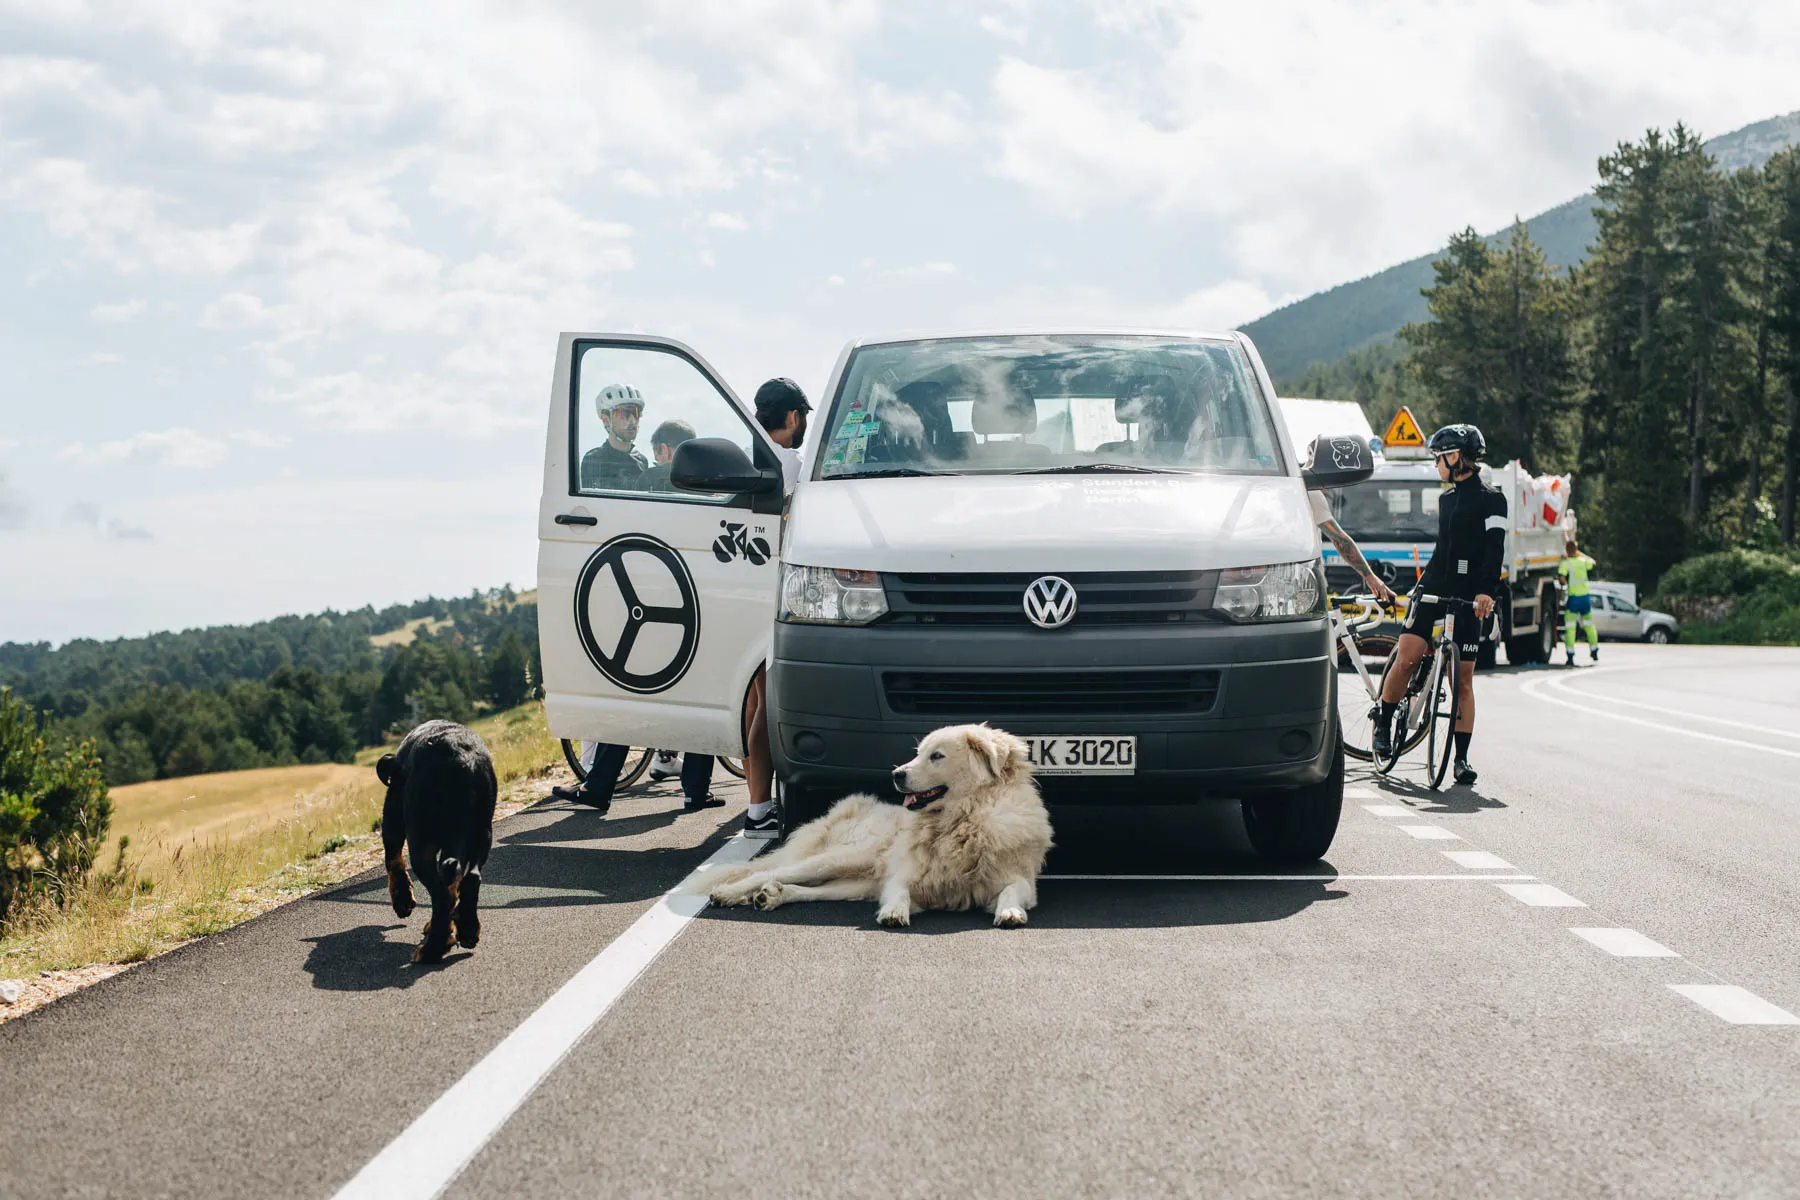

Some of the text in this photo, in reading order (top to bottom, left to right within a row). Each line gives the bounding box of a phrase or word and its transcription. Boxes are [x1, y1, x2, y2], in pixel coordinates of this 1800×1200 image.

[754, 526, 766, 534] TM
[1024, 577, 1076, 627] VW
[1065, 739, 1133, 766] 3020
